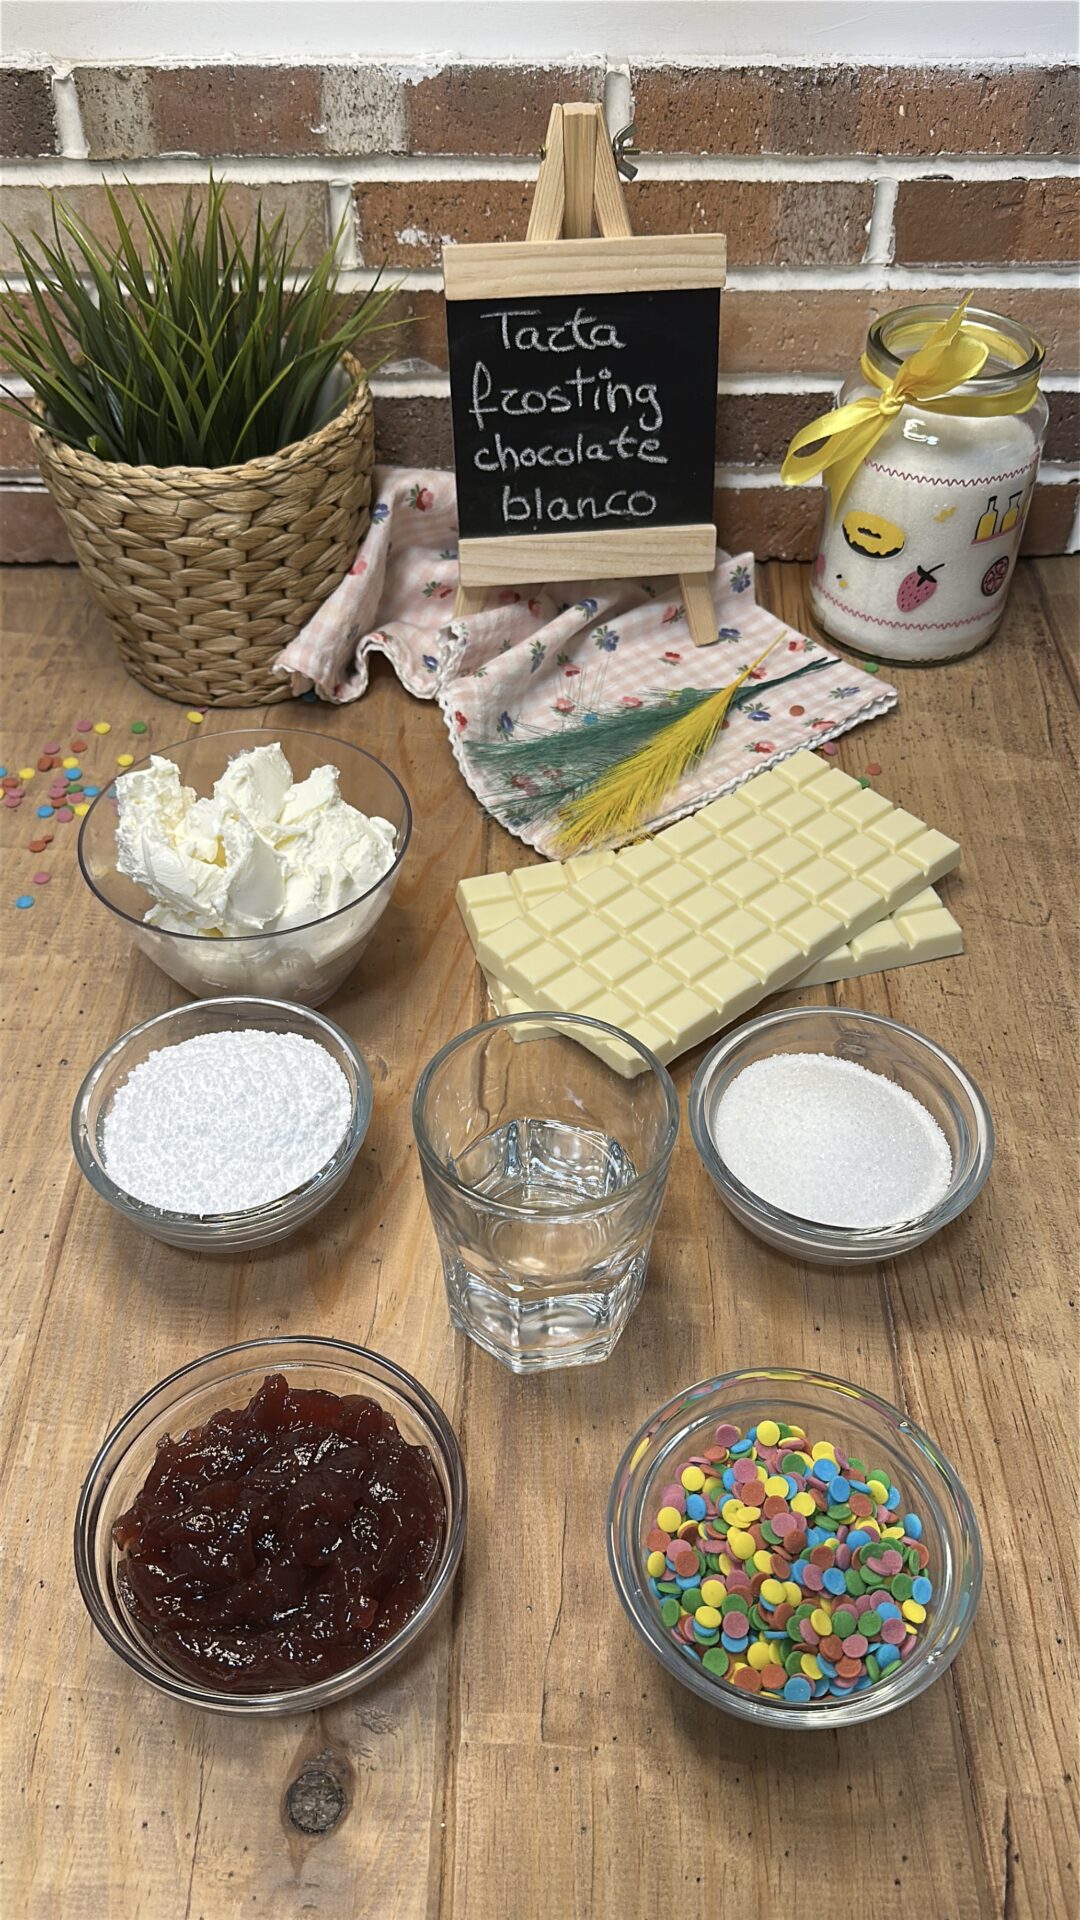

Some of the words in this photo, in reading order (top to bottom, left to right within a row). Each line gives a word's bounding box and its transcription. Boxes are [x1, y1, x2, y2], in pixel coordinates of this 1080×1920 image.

[480, 307, 627, 352] Tarta
[468, 361, 663, 431] frosting
[474, 425, 669, 472] chocolate
[502, 485, 657, 522] blanco
